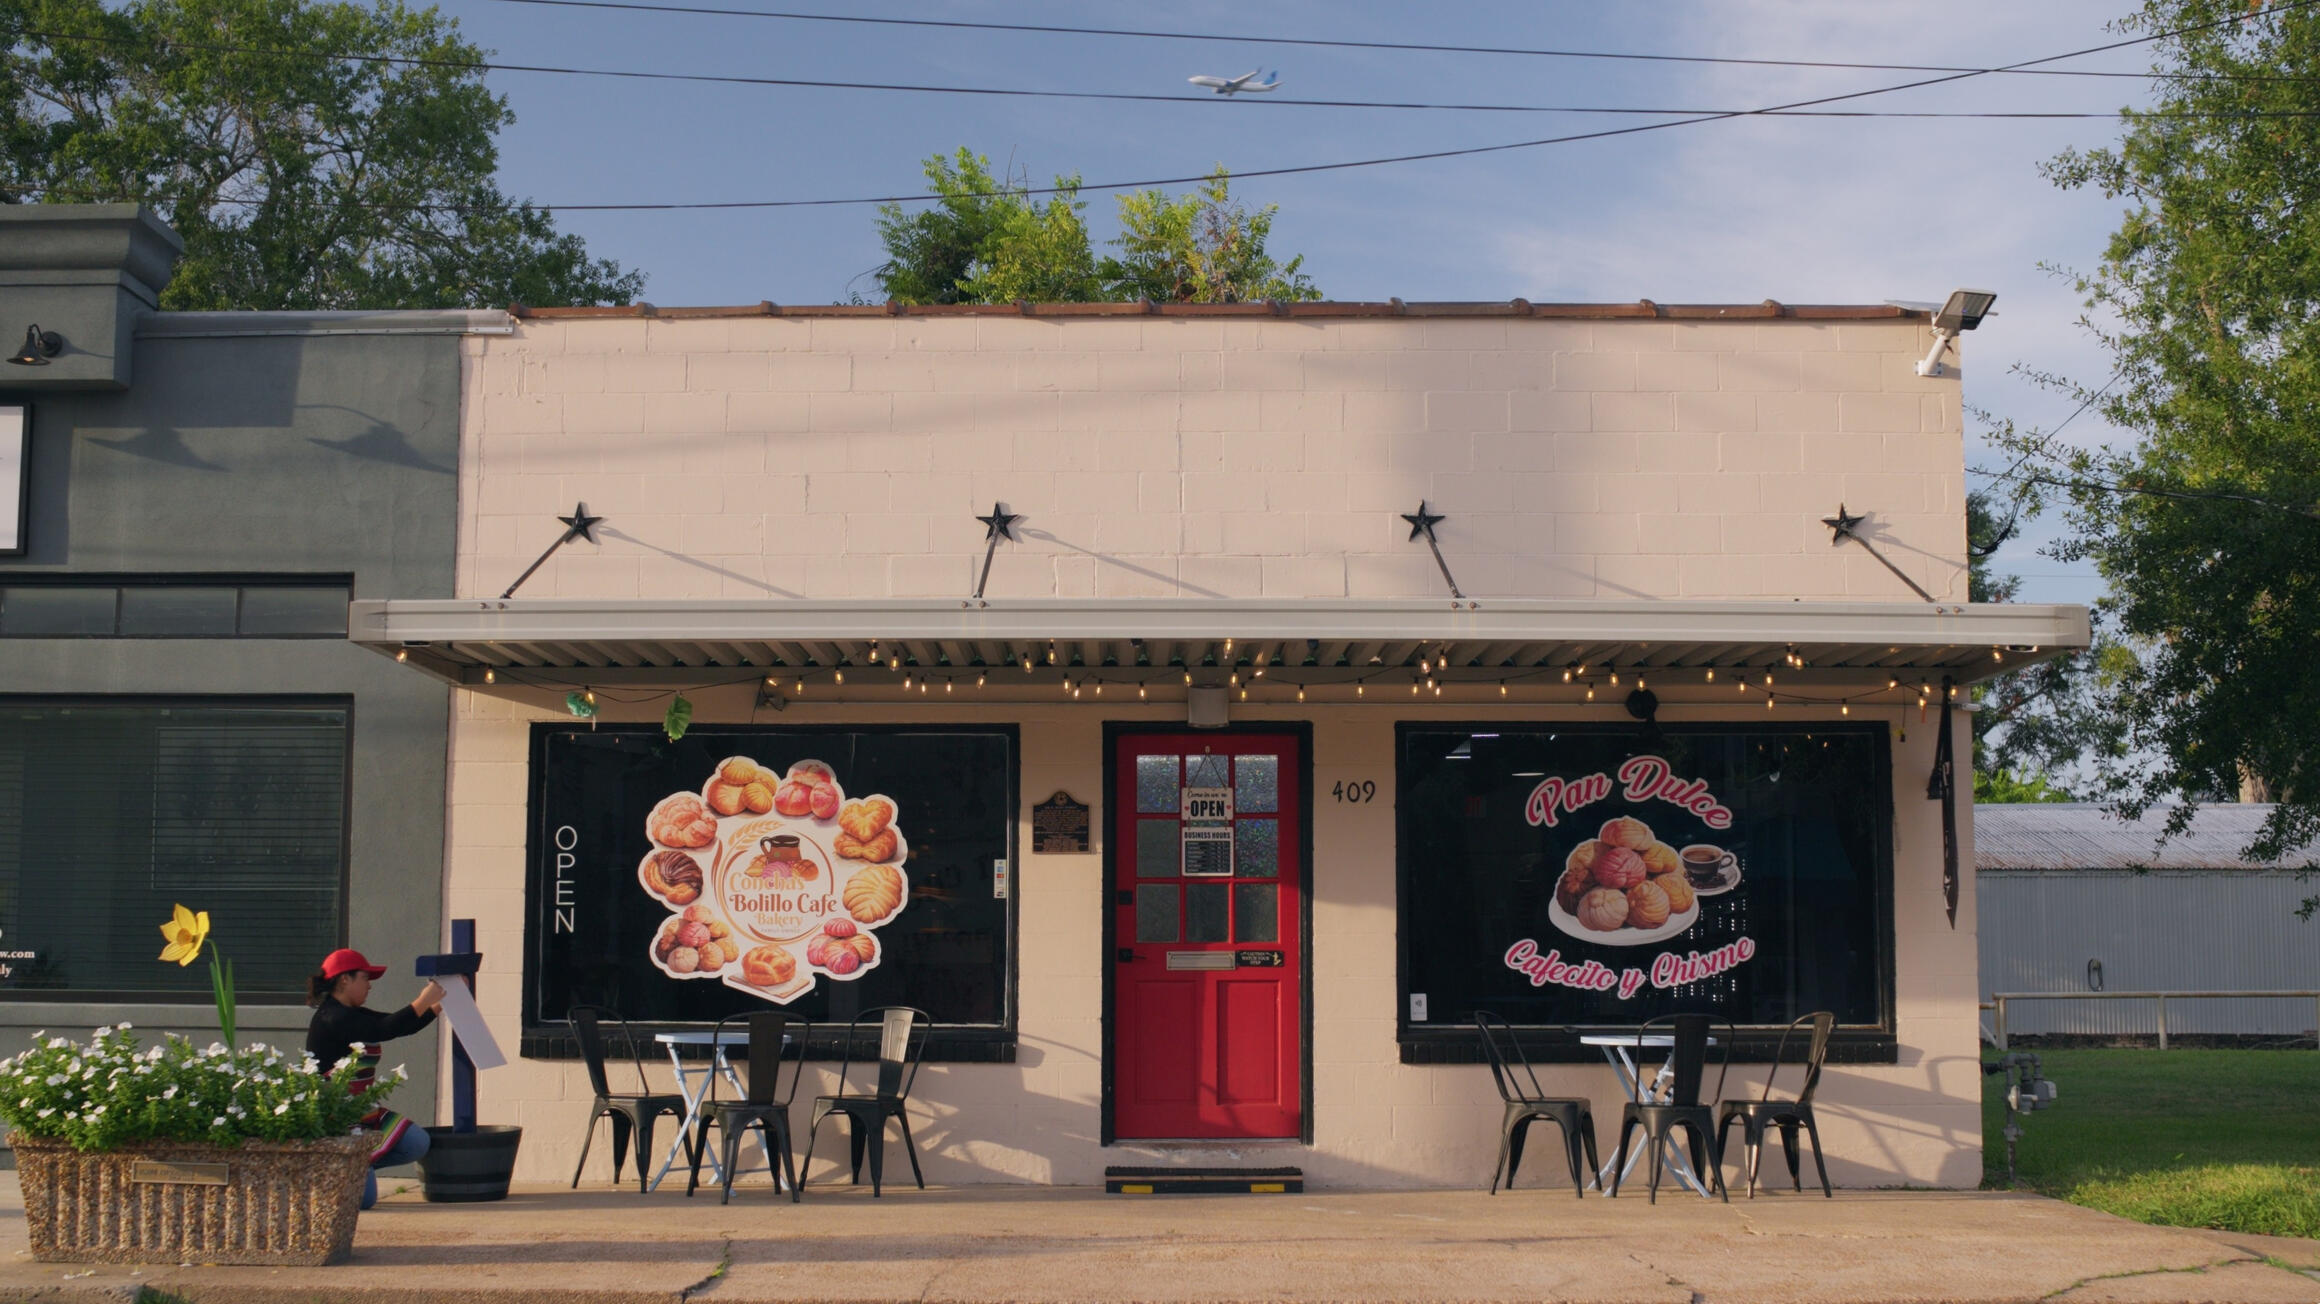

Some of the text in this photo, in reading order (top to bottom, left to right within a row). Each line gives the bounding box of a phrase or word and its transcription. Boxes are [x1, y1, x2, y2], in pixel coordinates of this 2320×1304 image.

[1332, 780, 1376, 804] 409
[1525, 755, 1733, 829] Pan Dulce
[1190, 800, 1225, 817] OPEN
[1184, 831, 1231, 839] BUSINESS HOURS
[555, 825, 578, 934] OPEN
[729, 893, 838, 918] Bolillo Cafe
[755, 912, 803, 927] Bakery
[1504, 936, 1755, 1000] Cafecito y Chisme
